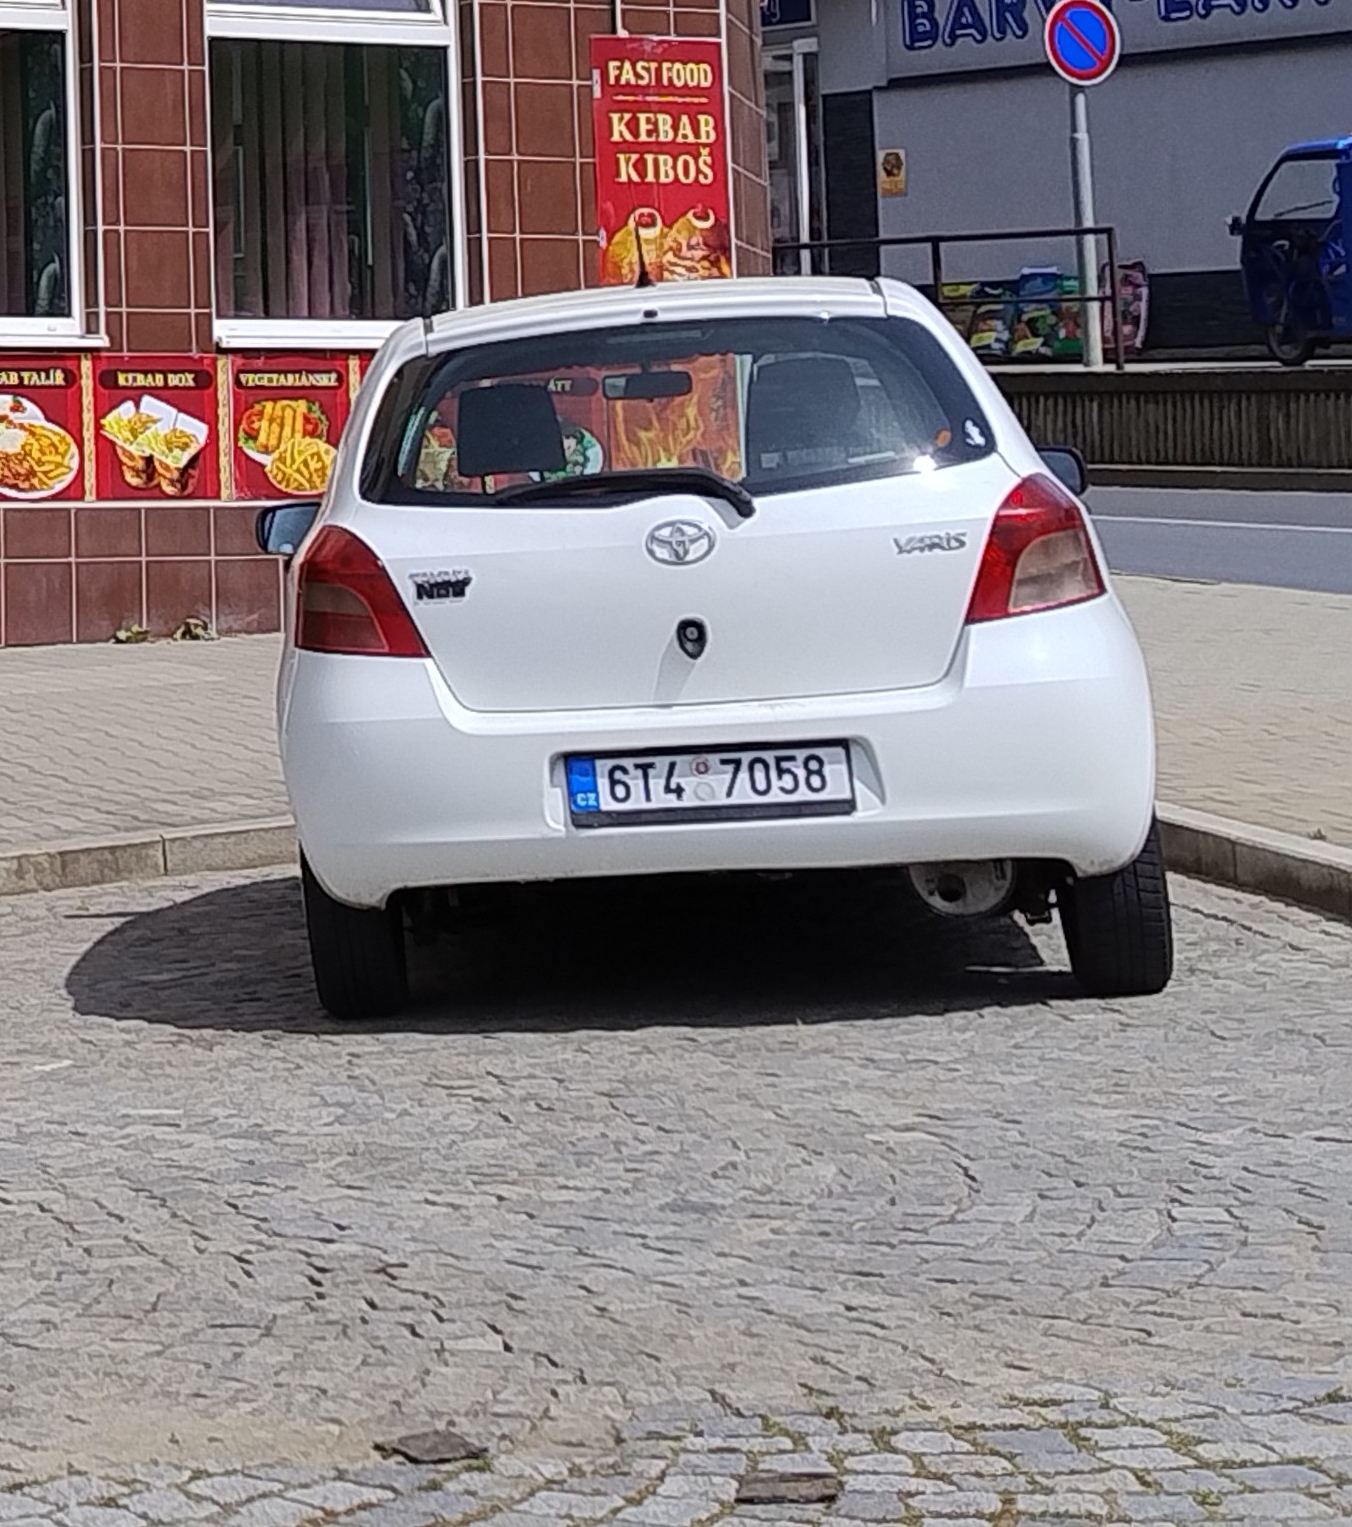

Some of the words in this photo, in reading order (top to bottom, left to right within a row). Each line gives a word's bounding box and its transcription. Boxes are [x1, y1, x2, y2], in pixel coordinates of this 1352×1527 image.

[608, 59, 657, 86] FAST
[661, 62, 713, 88] FOOD
[608, 112, 716, 143] KEBAB
[614, 146, 714, 185] KIBOŠ
[22, 368, 66, 386] TALÍŘ
[117, 371, 164, 386] KEBAB
[167, 372, 195, 387] BOX
[607, 760, 685, 804] 6T4
[719, 753, 827, 799] 7058
[576, 793, 598, 808] CZ
